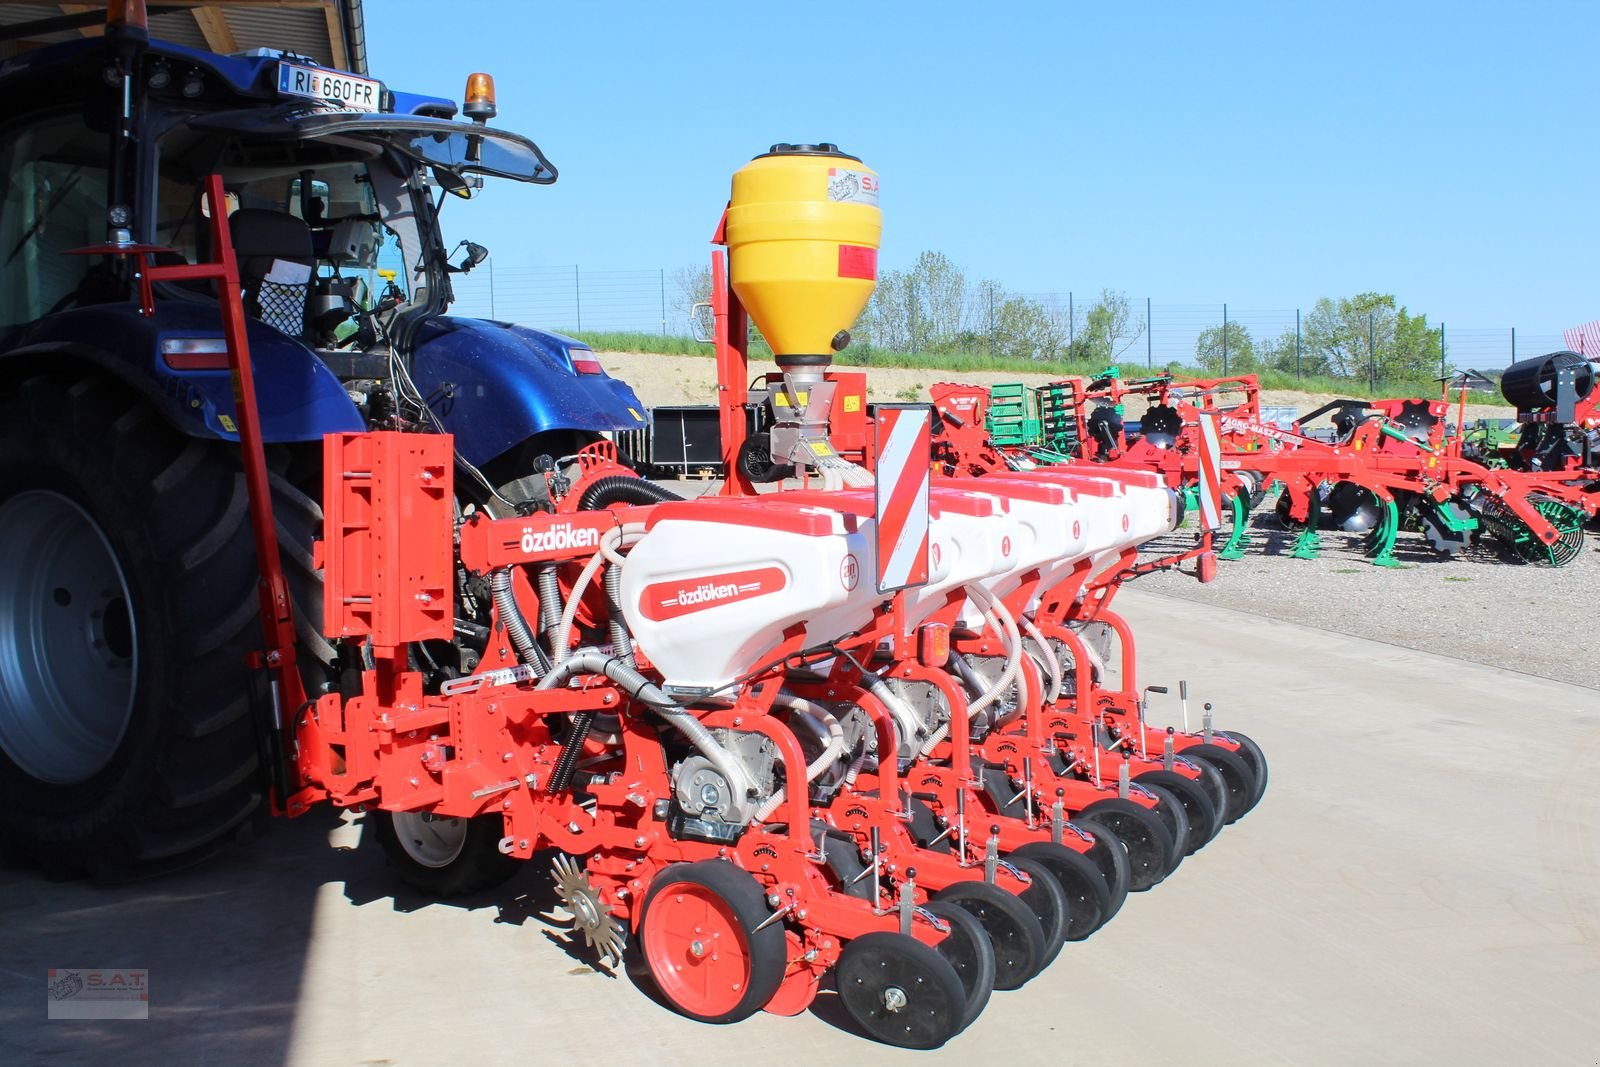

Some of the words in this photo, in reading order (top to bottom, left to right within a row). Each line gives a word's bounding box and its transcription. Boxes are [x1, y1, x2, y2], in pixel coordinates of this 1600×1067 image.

[295, 71, 310, 93] RI
[521, 522, 598, 553] özdöken
[678, 583, 738, 606] özdöken
